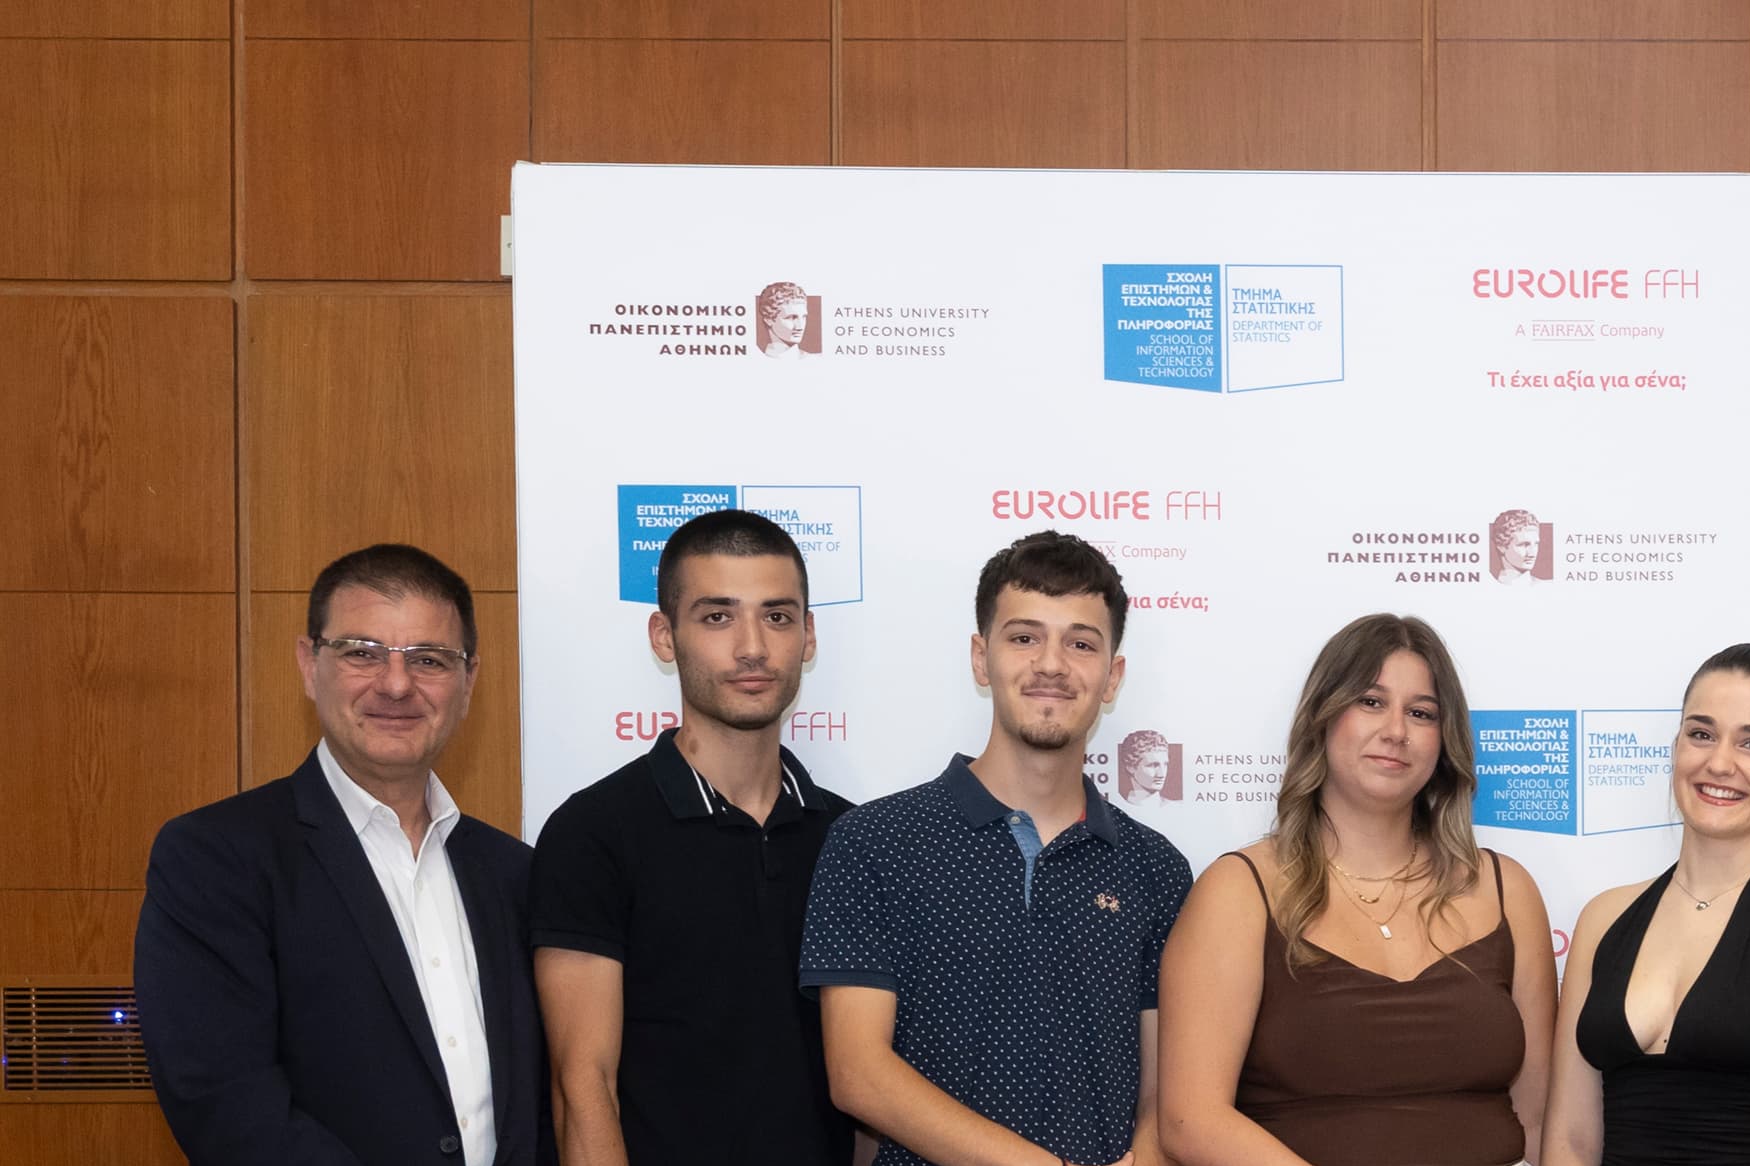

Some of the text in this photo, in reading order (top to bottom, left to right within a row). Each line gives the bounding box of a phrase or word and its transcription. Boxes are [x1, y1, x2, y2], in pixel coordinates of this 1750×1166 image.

[1167, 273, 1212, 282] ΣΧΟΛΗ
[1473, 269, 1698, 298] EUROLIFE FFH
[1121, 285, 1200, 294] ΕΠΙΣΤΗΜΩΝ
[1233, 289, 1281, 300] ΤΜΗΜΑ
[1121, 296, 1213, 306] ΤΕΧΝΟΛΟΓΙΑΣ
[615, 304, 747, 317] ΟΙΚΟΝΟΜΙΚΟ
[835, 307, 989, 319] ATHENS UNIVERSITY
[1186, 308, 1213, 318] ΤΗΣ
[1233, 302, 1315, 314] ΣΤΑΤΙΣΤΙΚΗΣ
[590, 324, 747, 336] ΠΑΝΕΠΙΣΤΗΜΙΟ
[1118, 320, 1213, 330] ΠΛΗΡΟΦΟΡΙΑΣ
[1233, 321, 1322, 331] DEPARTMENT OF
[835, 326, 955, 337] OF ECONOMICS
[1515, 325, 1664, 340] A FAIRFAX Company
[1150, 335, 1213, 344] SCHOOL OF
[1233, 333, 1290, 342] STATISTICS
[660, 344, 747, 356] ΑΘΗΝΩΝ
[835, 345, 946, 356] AND BUSINESS
[1137, 346, 1213, 355] INFORMATION
[1152, 357, 1202, 366] SCIENCES
[1139, 368, 1214, 377] TECHNOLOGY
[1488, 370, 1686, 391] Τι έχει αξία για σένα;
[683, 494, 728, 503] ΣΧΟΛΗ
[993, 490, 1220, 520] EUROLIFE FFH
[1353, 533, 1480, 544] ΟΙΚΟΝΟΜΙΚΟ
[1566, 534, 1718, 544] ATHENS UNIVERSITY
[1122, 545, 1187, 560] Company
[1566, 552, 1683, 563] OF ECONOMICS
[1328, 552, 1480, 564] ΠΑΝΕΠΙΣΤΗΜΙΟ
[1395, 572, 1480, 583] ΑΘΗΝΩΝ
[1566, 571, 1674, 581] AND BUSINESS
[1157, 592, 1208, 612] σένα;
[792, 712, 846, 741] FFH
[1525, 719, 1568, 728] ΣΧΟΛΗ
[1480, 730, 1556, 740] ΕΠΙΣΤΗΜΩΝ
[1589, 733, 1637, 744] ΤΜΗΜΑ
[1480, 742, 1568, 751] ΤΕΧΝΟΛΟΓΙΑΣ
[1589, 746, 1670, 758] ΣΤΑΤΙΣΤΙΚΗΣ
[1195, 755, 1253, 765] ATHENS
[1543, 754, 1568, 763] ΤΗΣ
[1476, 765, 1568, 774] ΠΛΗΡΟΦΟΡΙΑΣ
[1589, 764, 1658, 774] DEPARTMENT
[1196, 773, 1216, 783] OF
[1589, 776, 1645, 786] STATISTICS
[1507, 779, 1568, 788] SCHOOL OF
[1196, 792, 1228, 802] AND
[1494, 790, 1568, 799] INFORMATION
[1509, 800, 1559, 810] SCIENCES
[1496, 811, 1568, 821] TECHNOLOGY
